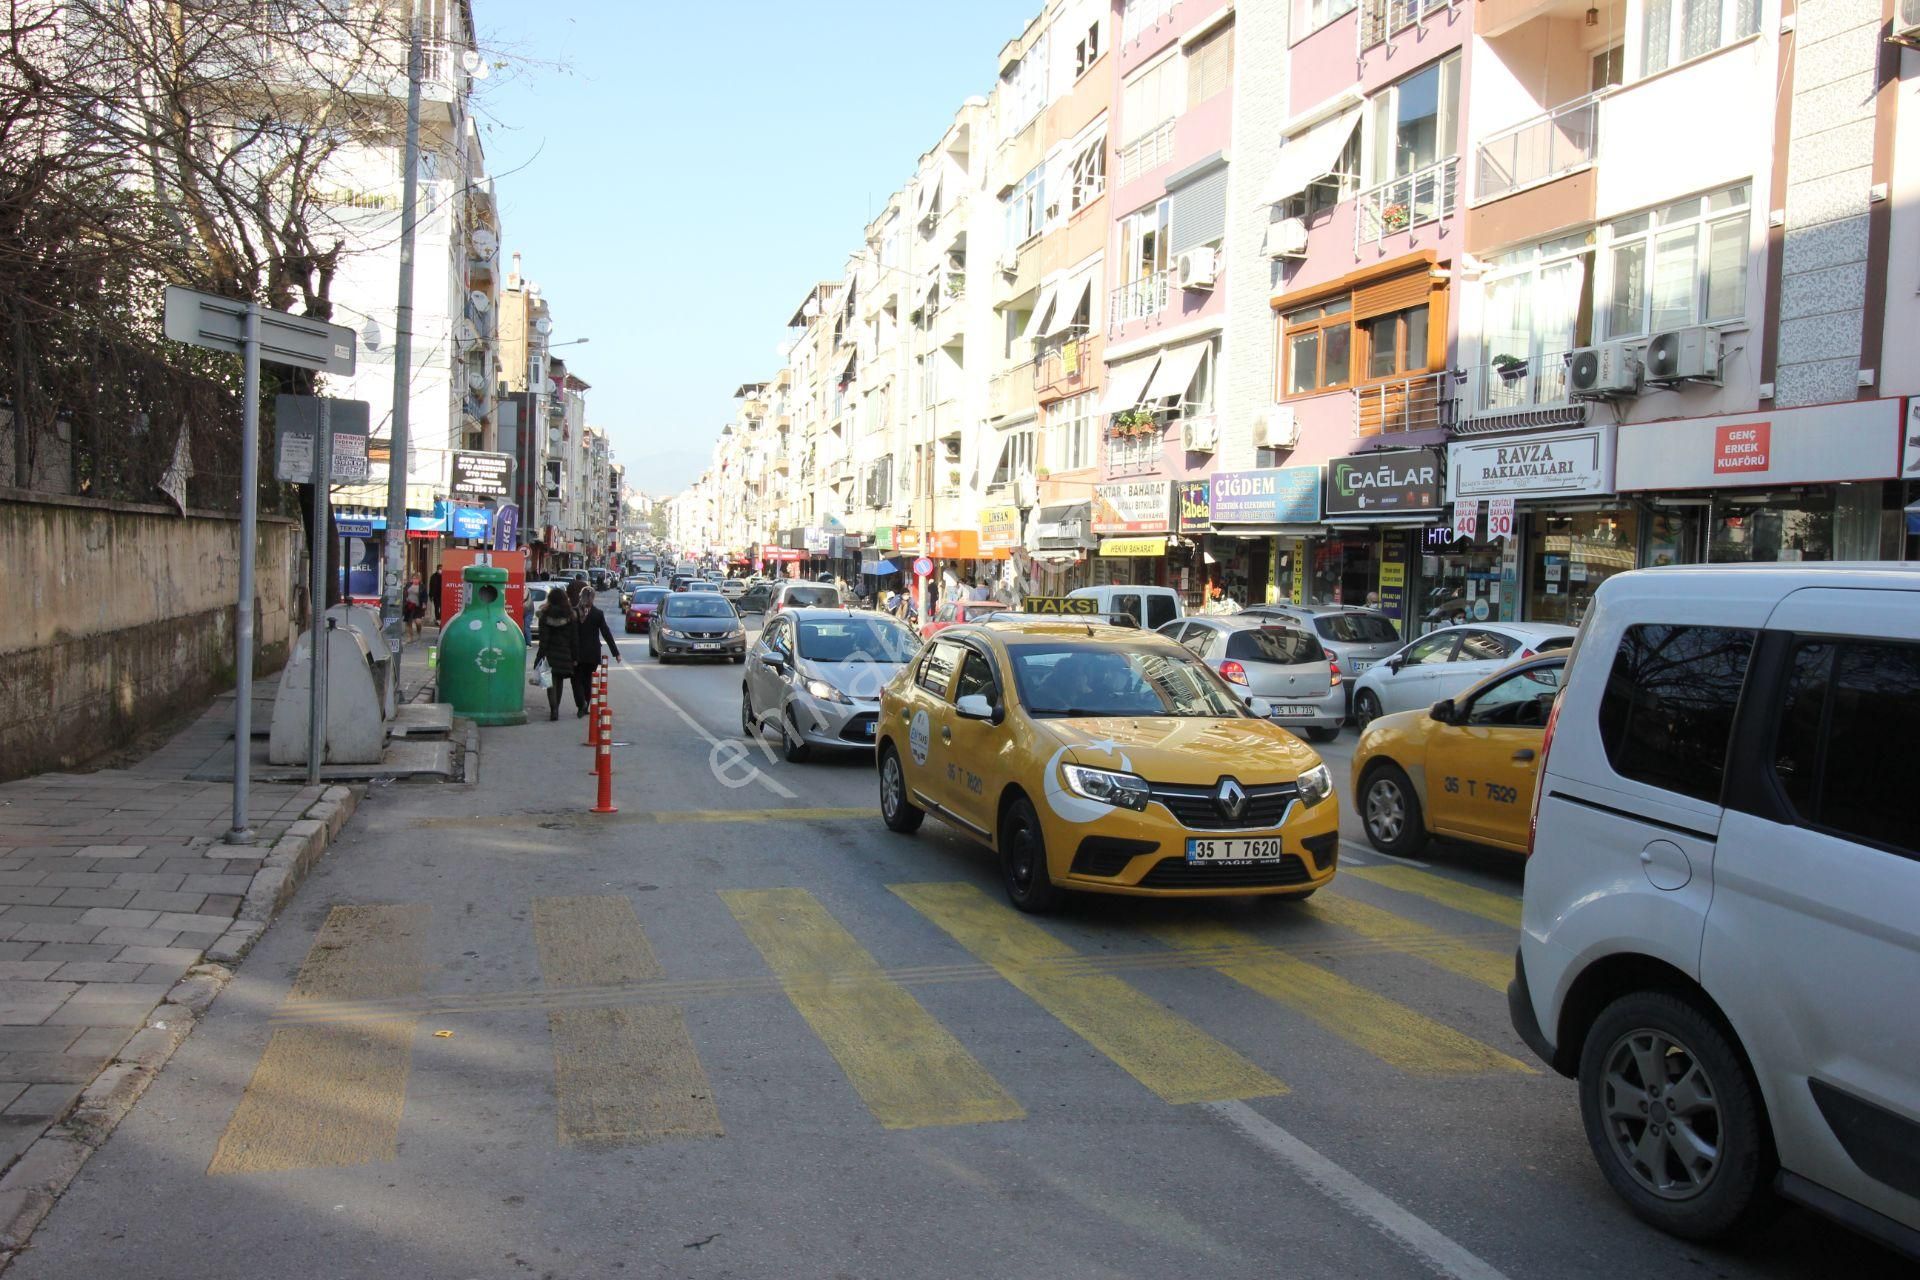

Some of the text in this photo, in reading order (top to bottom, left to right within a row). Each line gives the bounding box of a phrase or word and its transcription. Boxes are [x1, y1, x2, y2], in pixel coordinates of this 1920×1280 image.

[1729, 430, 1756, 441] GENÇ
[1497, 444, 1553, 465] RAVZA
[1725, 443, 1758, 454] ERKEK
[1718, 454, 1765, 468] KUAFÖRÜ
[1482, 461, 1574, 479] BAKLAVALARI
[1099, 486, 1121, 498] AKTAR
[1129, 483, 1165, 497] BAHARAT
[1215, 474, 1275, 501] ÇİĞDEM
[1182, 492, 1209, 518] tabela
[1457, 517, 1476, 534] 40
[1490, 516, 1509, 534] 30
[1428, 528, 1451, 544] HTC
[1129, 544, 1155, 553] BAHARAT
[1277, 706, 1284, 714] 35
[1444, 776, 1517, 803] 35 T 7529
[1197, 842, 1214, 857] 35
[1224, 842, 1233, 857] T
[1243, 841, 1278, 857] 7620
